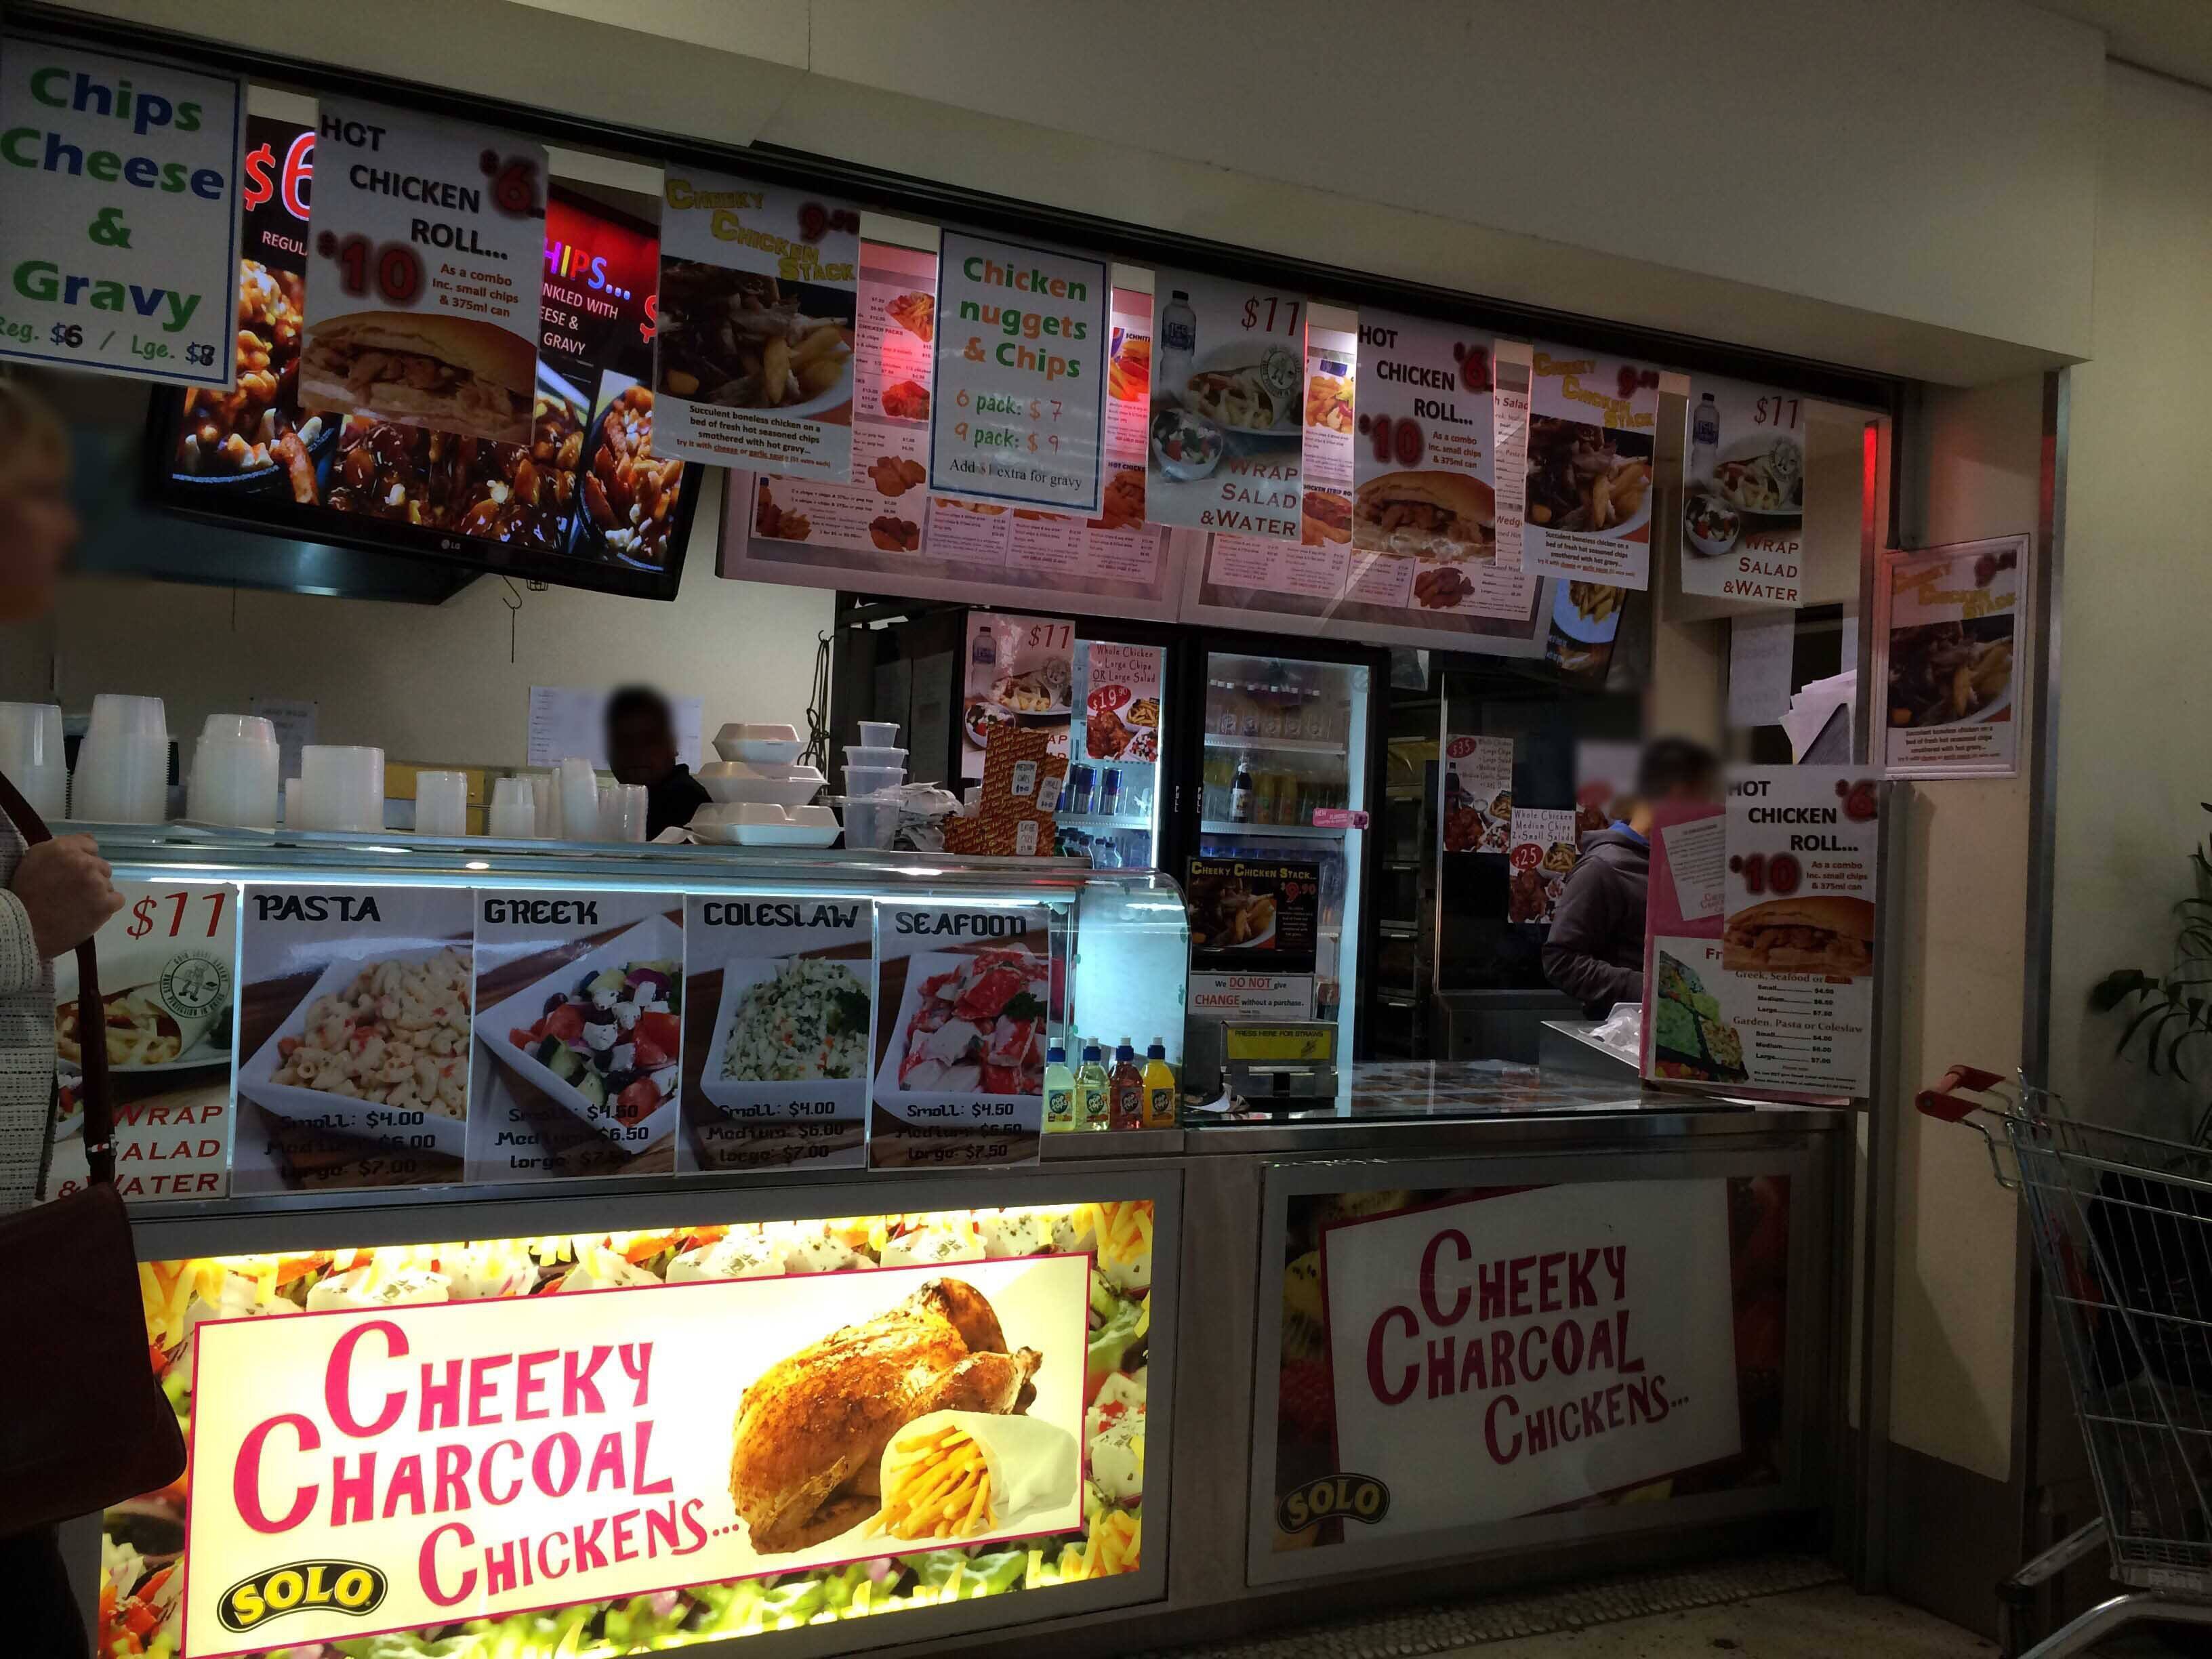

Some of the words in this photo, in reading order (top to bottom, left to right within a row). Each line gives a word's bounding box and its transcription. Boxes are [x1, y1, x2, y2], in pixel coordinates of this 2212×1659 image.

[30, 68, 202, 134] Chips
[321, 114, 386, 151] HOT
[1, 127, 224, 200] Cheese
[350, 164, 480, 213] CHICKEN
[88, 207, 132, 249] &
[411, 218, 508, 260] ROLL...
[711, 209, 819, 266] CHICKEN
[441, 264, 456, 276] As
[459, 268, 468, 277] a
[470, 269, 512, 287] combo
[544, 239, 632, 301] HIPS...
[777, 255, 856, 282] STACK
[964, 256, 1086, 302] Chicken
[13, 260, 201, 331] Gravy
[432, 279, 453, 292] Inc.
[455, 283, 487, 298] small
[489, 287, 518, 304] chips
[439, 295, 449, 305] &
[452, 296, 489, 314] 375ml
[491, 305, 510, 318] can
[586, 295, 619, 321] WITH
[1242, 295, 1300, 336] $11
[568, 314, 578, 330] &
[960, 300, 1087, 340] nuggets
[50, 322, 83, 348] $6
[131, 333, 175, 361] Lge.
[186, 342, 216, 367] $8
[543, 331, 586, 356] GRAVY
[1359, 325, 1398, 350] HOT
[964, 337, 986, 364] &
[996, 342, 1080, 380] Chips
[1377, 360, 1455, 392] CHICKEN
[689, 405, 730, 419] Succulent
[733, 412, 769, 424] boneless
[771, 418, 801, 429] chicken
[956, 390, 970, 407] 6
[976, 394, 1021, 415] pack:
[1030, 401, 1040, 421] $
[1050, 400, 1062, 422] 7
[1414, 398, 1473, 426] ROLL...
[1754, 395, 1798, 429] $11
[690, 417, 706, 426] bed
[719, 422, 741, 432] fresh
[743, 425, 756, 434] hot
[758, 428, 797, 441] seasoned
[799, 434, 820, 444] chips
[698, 431, 744, 444] smothered
[746, 437, 764, 447] with
[766, 441, 780, 450] hot
[954, 422, 968, 441] 9
[974, 428, 1019, 449] pack:
[1027, 432, 1038, 453] $
[1048, 434, 1059, 455] 9
[1433, 431, 1443, 441] As
[1452, 434, 1477, 446] combo
[696, 441, 712, 451] with
[714, 444, 738, 455] cheese
[1429, 443, 1441, 453] Inc.
[1443, 445, 1462, 456] small
[1462, 447, 1481, 459] chips
[949, 459, 975, 474] Add
[997, 467, 1027, 480] extra
[1029, 470, 1047, 483] for
[1050, 474, 1082, 491] gravy
[1229, 459, 1298, 481] WRAP
[1465, 461, 1477, 469] can
[1221, 483, 1297, 509] SALAD
[1744, 534, 1799, 554] WRAP
[1739, 557, 1797, 578] SALAD
[1029, 624, 1070, 649] $11
[1096, 645, 1120, 655] Whole
[1092, 670, 1106, 682] OR
[1109, 672, 1130, 683] Large
[1134, 673, 1155, 683] Salad
[1129, 660, 1151, 671] Chips
[1727, 780, 1771, 796] HOT
[1514, 810, 1537, 819] Whole
[1541, 811, 1572, 820] Chicken
[1549, 821, 1570, 831] Chips
[1748, 807, 1837, 824] CHICKEN
[1790, 835, 1858, 852] ROLL...
[1515, 848, 1536, 865] $25
[1811, 861, 1823, 869] As
[1831, 861, 1863, 869] combo
[1191, 861, 1231, 876] CHEEKY
[1234, 863, 1277, 879] CHICKEN
[1806, 872, 1821, 880] Inc.
[1823, 872, 1845, 880] small
[1847, 872, 1868, 882] chips
[127, 892, 226, 941] $11
[253, 895, 381, 923] PASTA
[485, 899, 598, 926] GREEK
[704, 902, 859, 928] COLESLAW
[895, 912, 1027, 937] SEAFOOD
[1229, 977, 1245, 989] DO
[1248, 977, 1271, 989] NOT
[1274, 981, 1286, 989] give
[1770, 973, 1809, 982] Seafood
[1195, 994, 1240, 1006] CHANGE
[1242, 998, 1266, 1006] without
[1776, 1019, 1801, 1029] Pasta
[1818, 1023, 1863, 1033] Coleslaw
[112, 1105, 224, 1127] WRAP
[366, 1111, 424, 1128] $4.00
[587, 1105, 638, 1121] $4.50
[718, 1104, 780, 1119] Small:
[789, 1101, 835, 1117] $4.00
[907, 1104, 964, 1118] Small:
[972, 1103, 1014, 1117] $4.50
[379, 1134, 436, 1150] $6.00
[600, 1126, 649, 1141] $6.50
[798, 1122, 844, 1139] $6.00
[966, 1144, 1008, 1158] $7.50
[358, 1160, 417, 1177] $7.00
[1419, 1229, 1627, 1326] CHEEKY
[1366, 1305, 1645, 1404] CHARCOAL
[323, 1319, 654, 1439] CHEEKY
[1483, 1375, 1689, 1465] CHICKENS...
[232, 1411, 674, 1534] CHARCOAL
[1288, 1480, 1384, 1524] SOLO
[417, 1497, 741, 1607] CHICKENS...
[230, 1565, 373, 1625] SOLO
